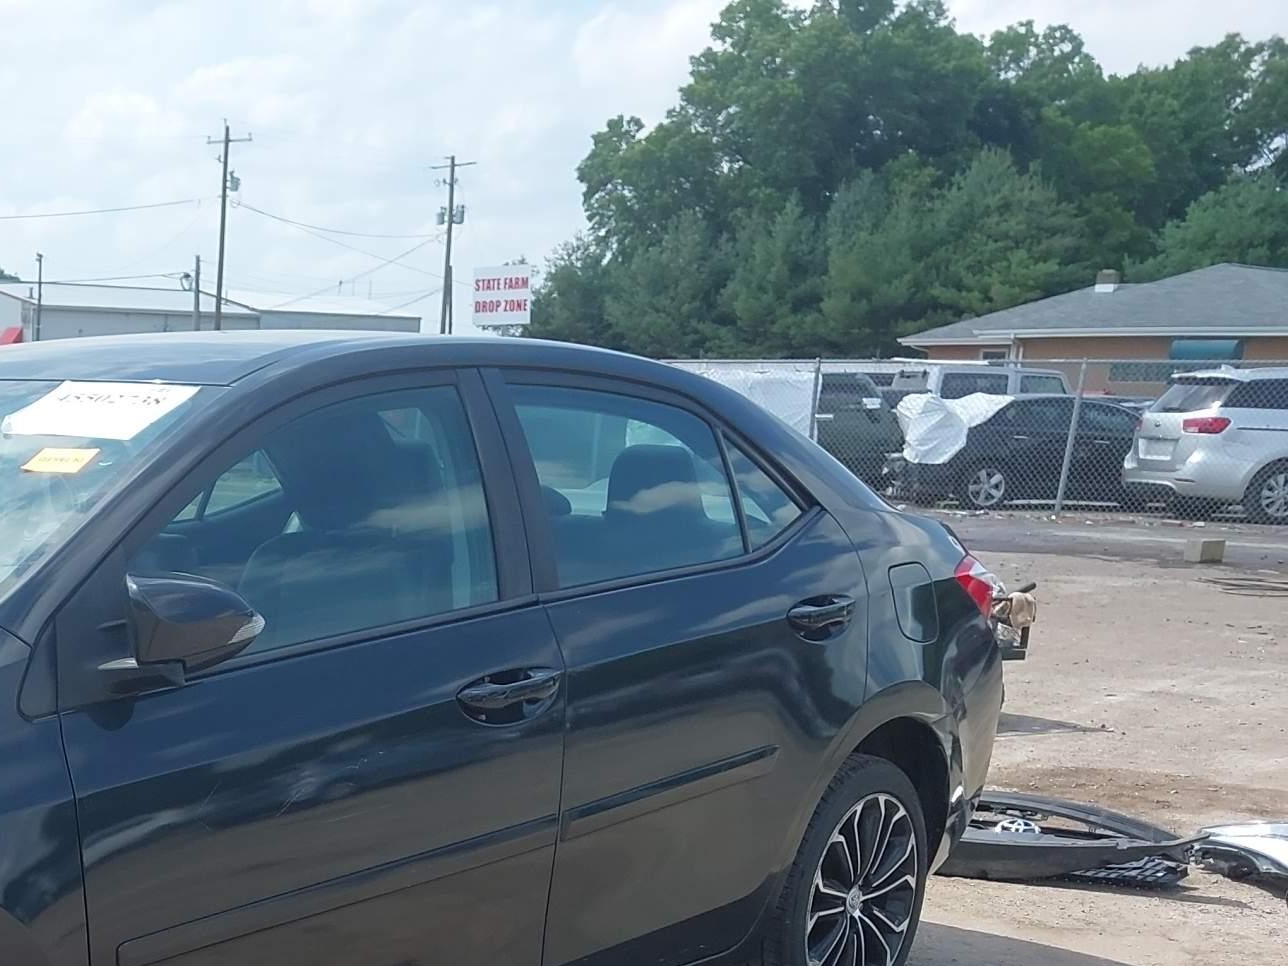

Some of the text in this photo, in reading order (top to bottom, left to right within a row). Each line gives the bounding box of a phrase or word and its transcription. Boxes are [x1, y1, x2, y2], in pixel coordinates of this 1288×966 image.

[474, 276, 529, 292] STATE FARM
[474, 298, 528, 313] DROP ZONE
